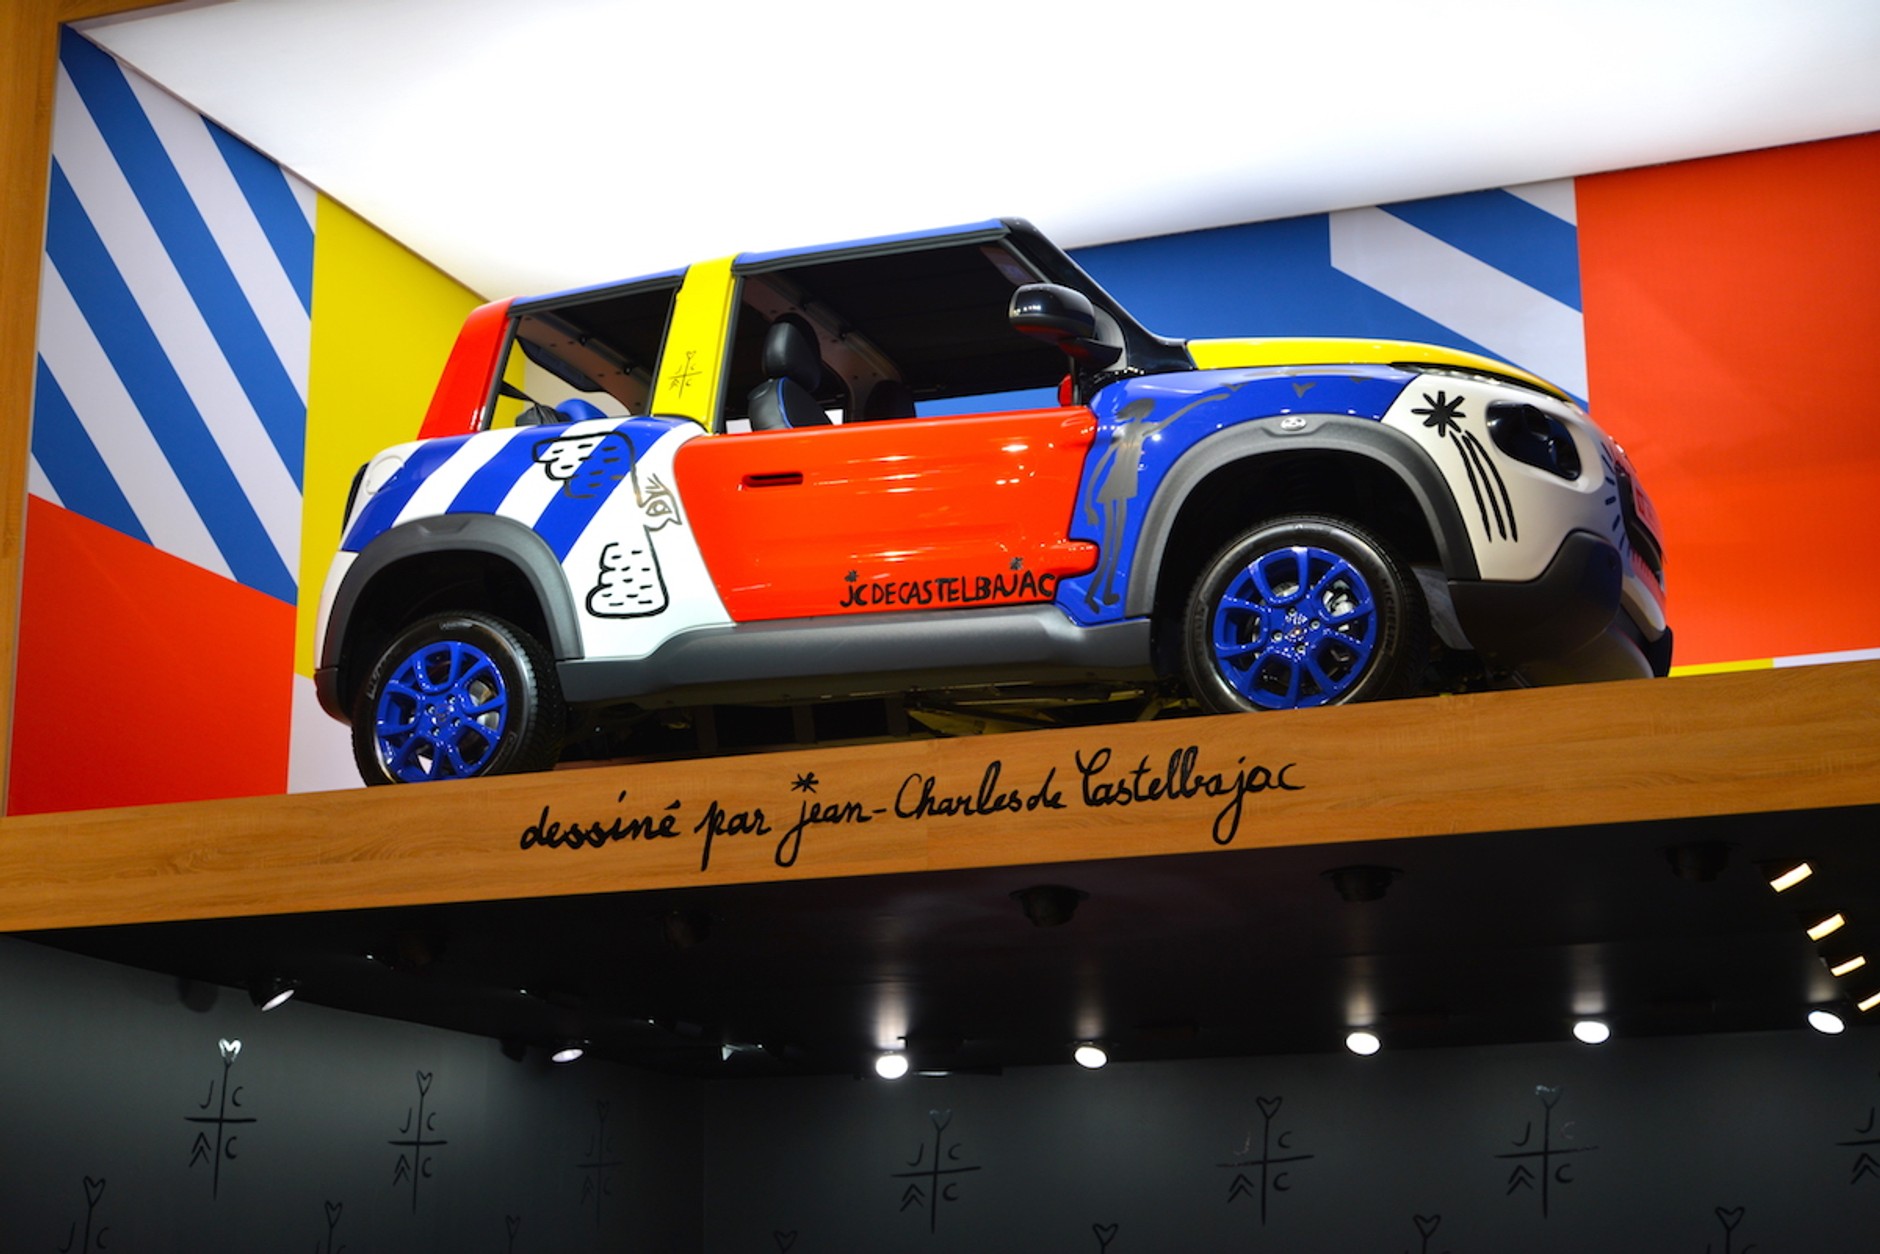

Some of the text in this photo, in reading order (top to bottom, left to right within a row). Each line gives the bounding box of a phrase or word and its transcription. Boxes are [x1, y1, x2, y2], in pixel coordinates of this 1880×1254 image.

[520, 790, 681, 850] dessiné
[694, 800, 772, 871] par
[1075, 745, 1306, 845] Castelbajac
